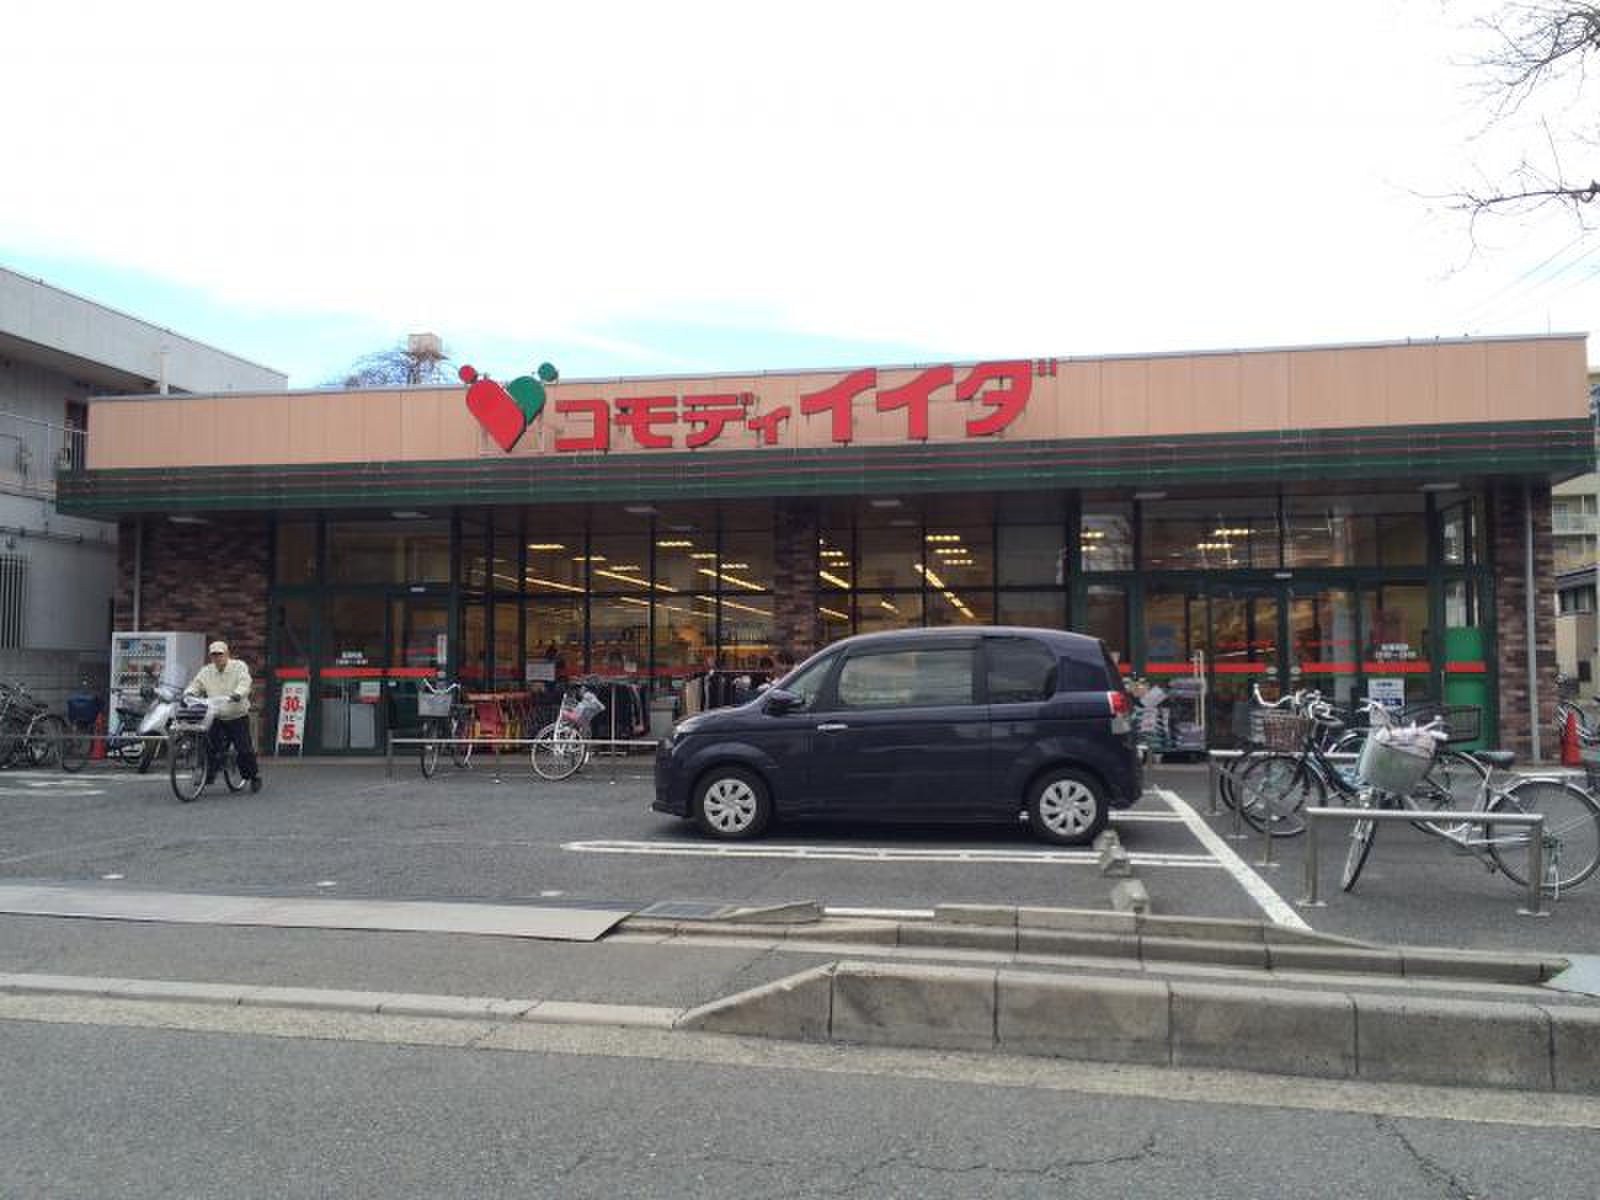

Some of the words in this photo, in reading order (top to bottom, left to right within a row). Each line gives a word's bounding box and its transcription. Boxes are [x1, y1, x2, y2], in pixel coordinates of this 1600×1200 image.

[555, 359, 1057, 451] コモディイイダ
